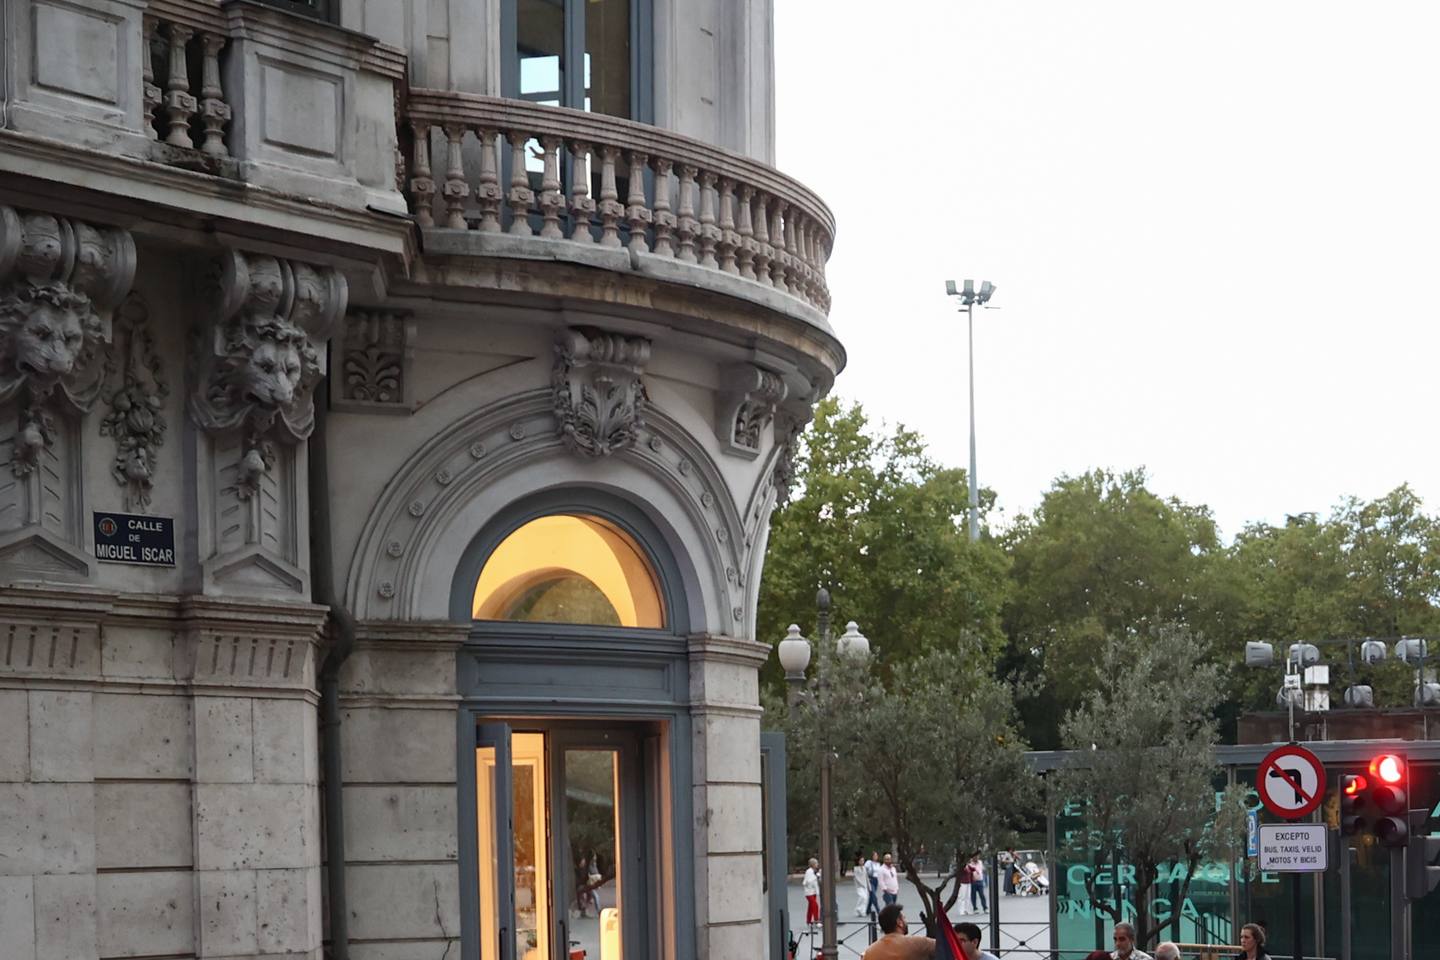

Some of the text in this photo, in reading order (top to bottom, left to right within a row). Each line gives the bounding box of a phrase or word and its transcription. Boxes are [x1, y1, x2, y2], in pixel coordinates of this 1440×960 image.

[128, 520, 163, 531] CALLE
[128, 534, 141, 542] DE
[96, 543, 173, 562] MIGUEL ISCAR
[1275, 832, 1310, 841] EXCEPTO
